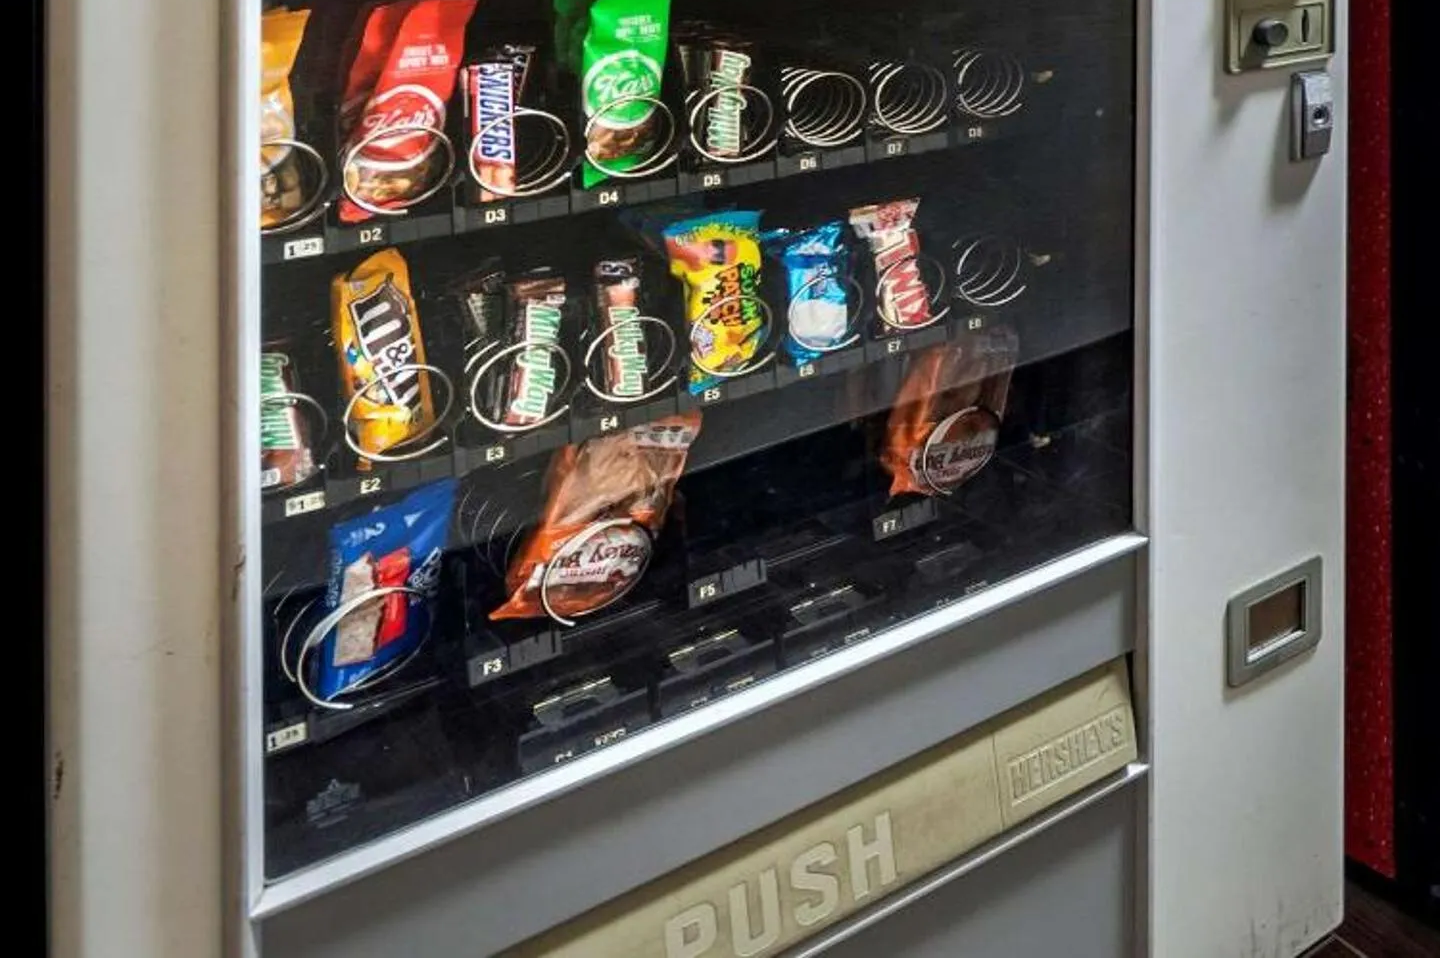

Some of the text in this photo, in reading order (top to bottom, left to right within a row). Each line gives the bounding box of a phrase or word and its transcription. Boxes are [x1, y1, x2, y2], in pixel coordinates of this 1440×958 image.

[478, 65, 512, 161] SNICKERS
[599, 191, 619, 205] D4
[485, 208, 506, 224] D3
[359, 227, 382, 244] D2
[704, 389, 721, 402] E5
[600, 416, 619, 431] E4
[486, 446, 505, 462] E3
[359, 477, 381, 494] E2
[882, 519, 896, 533] F7
[700, 583, 716, 599] F5
[483, 658, 502, 675] F3
[1009, 713, 1126, 800] HERSHEY'S
[663, 809, 900, 958] PUSH
